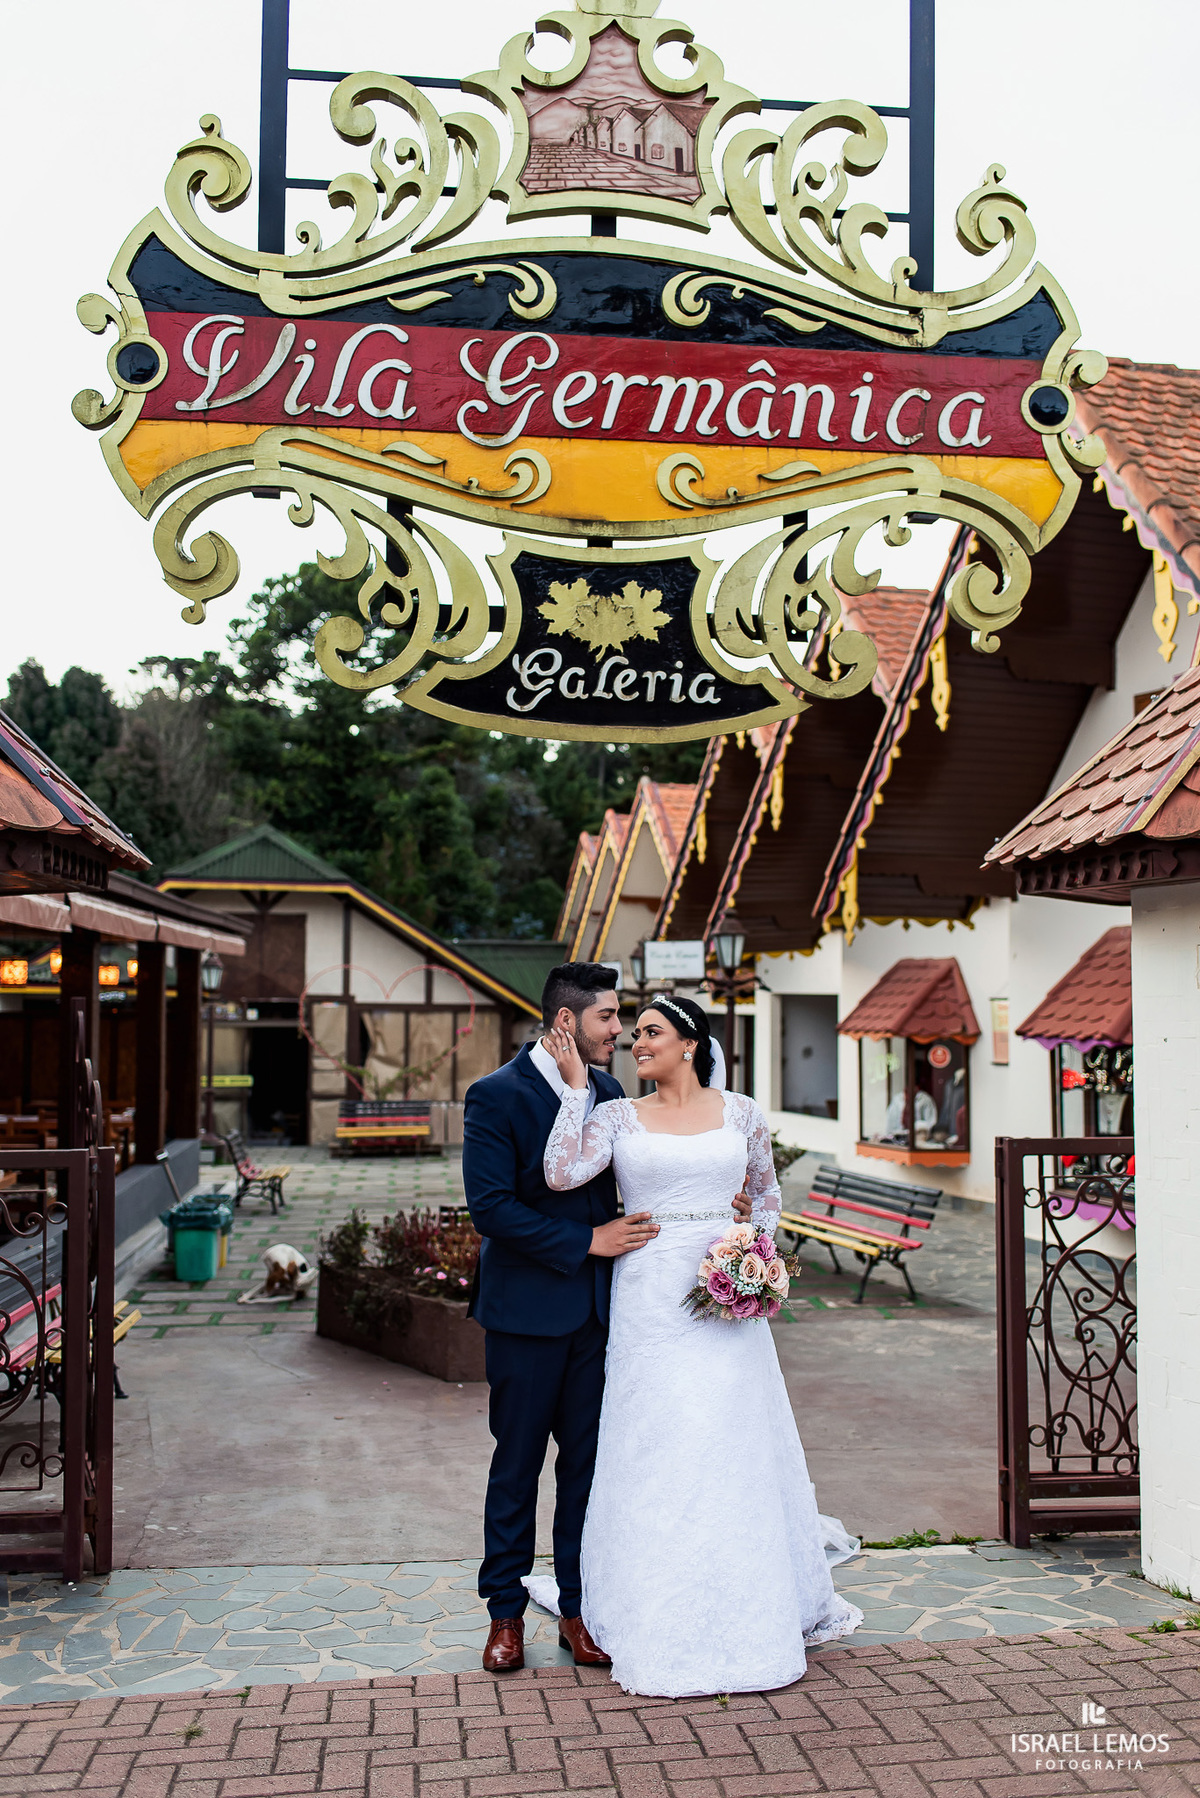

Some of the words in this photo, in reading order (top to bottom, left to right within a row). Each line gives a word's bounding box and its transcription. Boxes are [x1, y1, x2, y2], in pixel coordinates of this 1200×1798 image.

[175, 314, 417, 420] Vila
[456, 332, 992, 448] Germânica
[506, 648, 721, 711] Galeria
